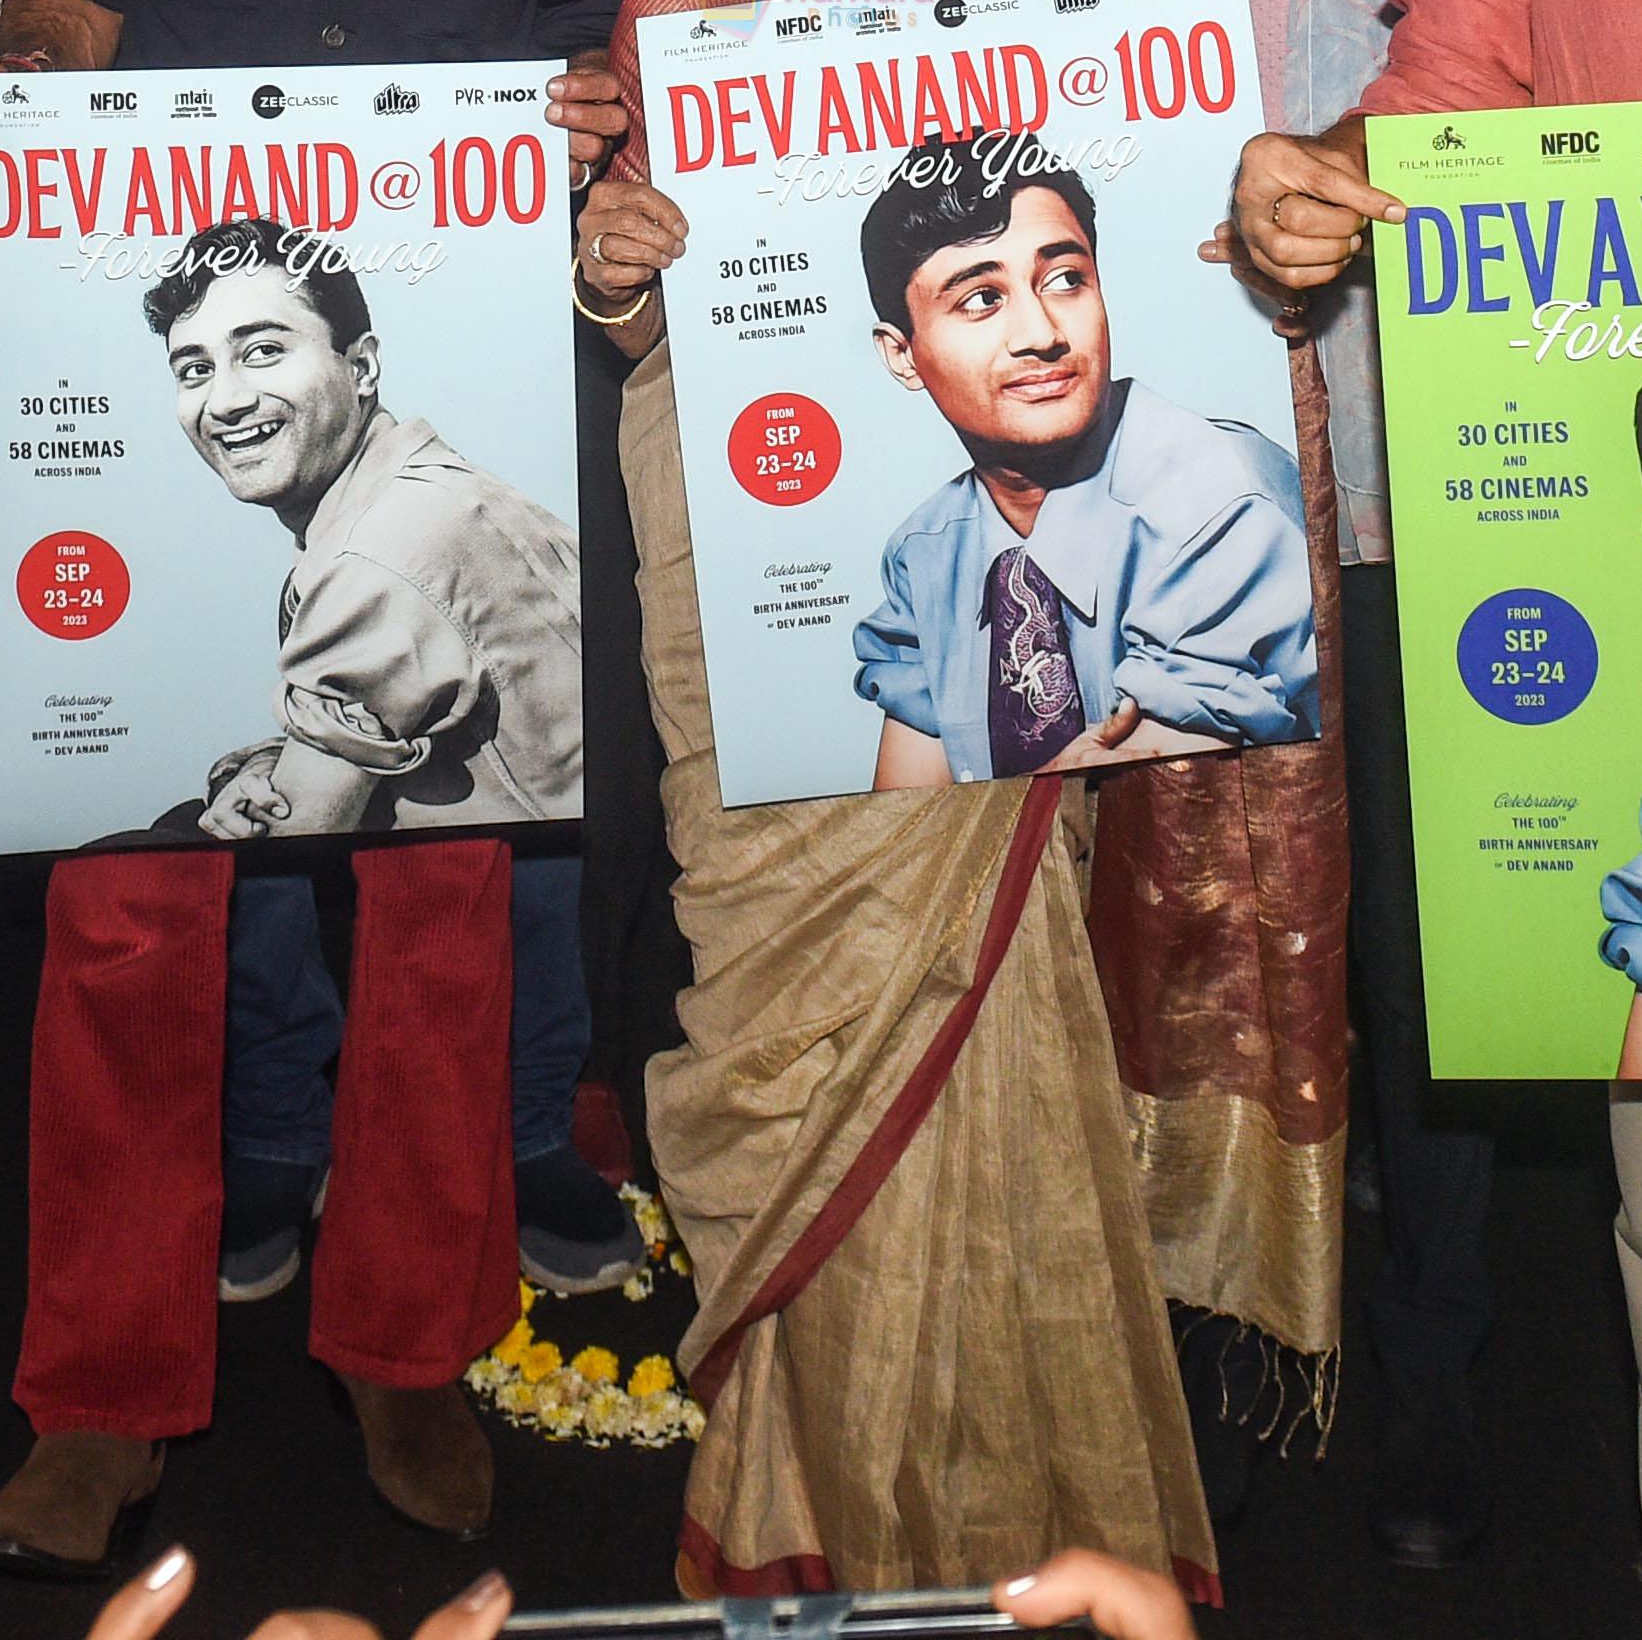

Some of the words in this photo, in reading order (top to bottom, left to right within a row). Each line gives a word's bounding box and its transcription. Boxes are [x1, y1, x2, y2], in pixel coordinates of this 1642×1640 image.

[776, 15, 822, 36] NFDC
[91, 92, 137, 111] NFDC
[667, 70, 796, 174] DEV
[817, 44, 1049, 157] ANAND
[1059, 57, 1109, 106] @
[1114, 21, 1236, 122] 100
[1541, 131, 1600, 156] NFDC
[973, 124, 1143, 199] Young
[1398, 160, 1429, 171] FILM
[1434, 156, 1505, 169] HERITAGE
[123, 142, 359, 236] ANAND
[370, 161, 420, 210] @
[428, 134, 547, 228] 100
[278, 226, 448, 293] Young
[719, 260, 743, 279] 30
[749, 252, 809, 276] CITIES
[1406, 200, 1564, 316] DEV
[711, 307, 735, 325] 58
[740, 296, 828, 322] CINEMAS
[737, 328, 776, 341] ACROSS
[778, 325, 806, 337] INDIA
[20, 397, 43, 415] 30
[49, 396, 109, 414] CITIES
[765, 426, 801, 447] SEP
[1458, 424, 1487, 446] 30
[1494, 422, 1569, 444] CITIES
[9, 442, 31, 460] 58
[38, 440, 125, 459] CINEMAS
[777, 480, 801, 491] 2023
[1445, 479, 1473, 502] 58
[1480, 476, 1589, 500] CINEMAS
[1477, 510, 1523, 521] ACROSS
[1527, 509, 1560, 520] INDIA
[55, 564, 90, 582] SEP
[1507, 608, 1541, 620] FROM
[1504, 629, 1548, 652] SEP
[1515, 694, 1545, 707] 2023
